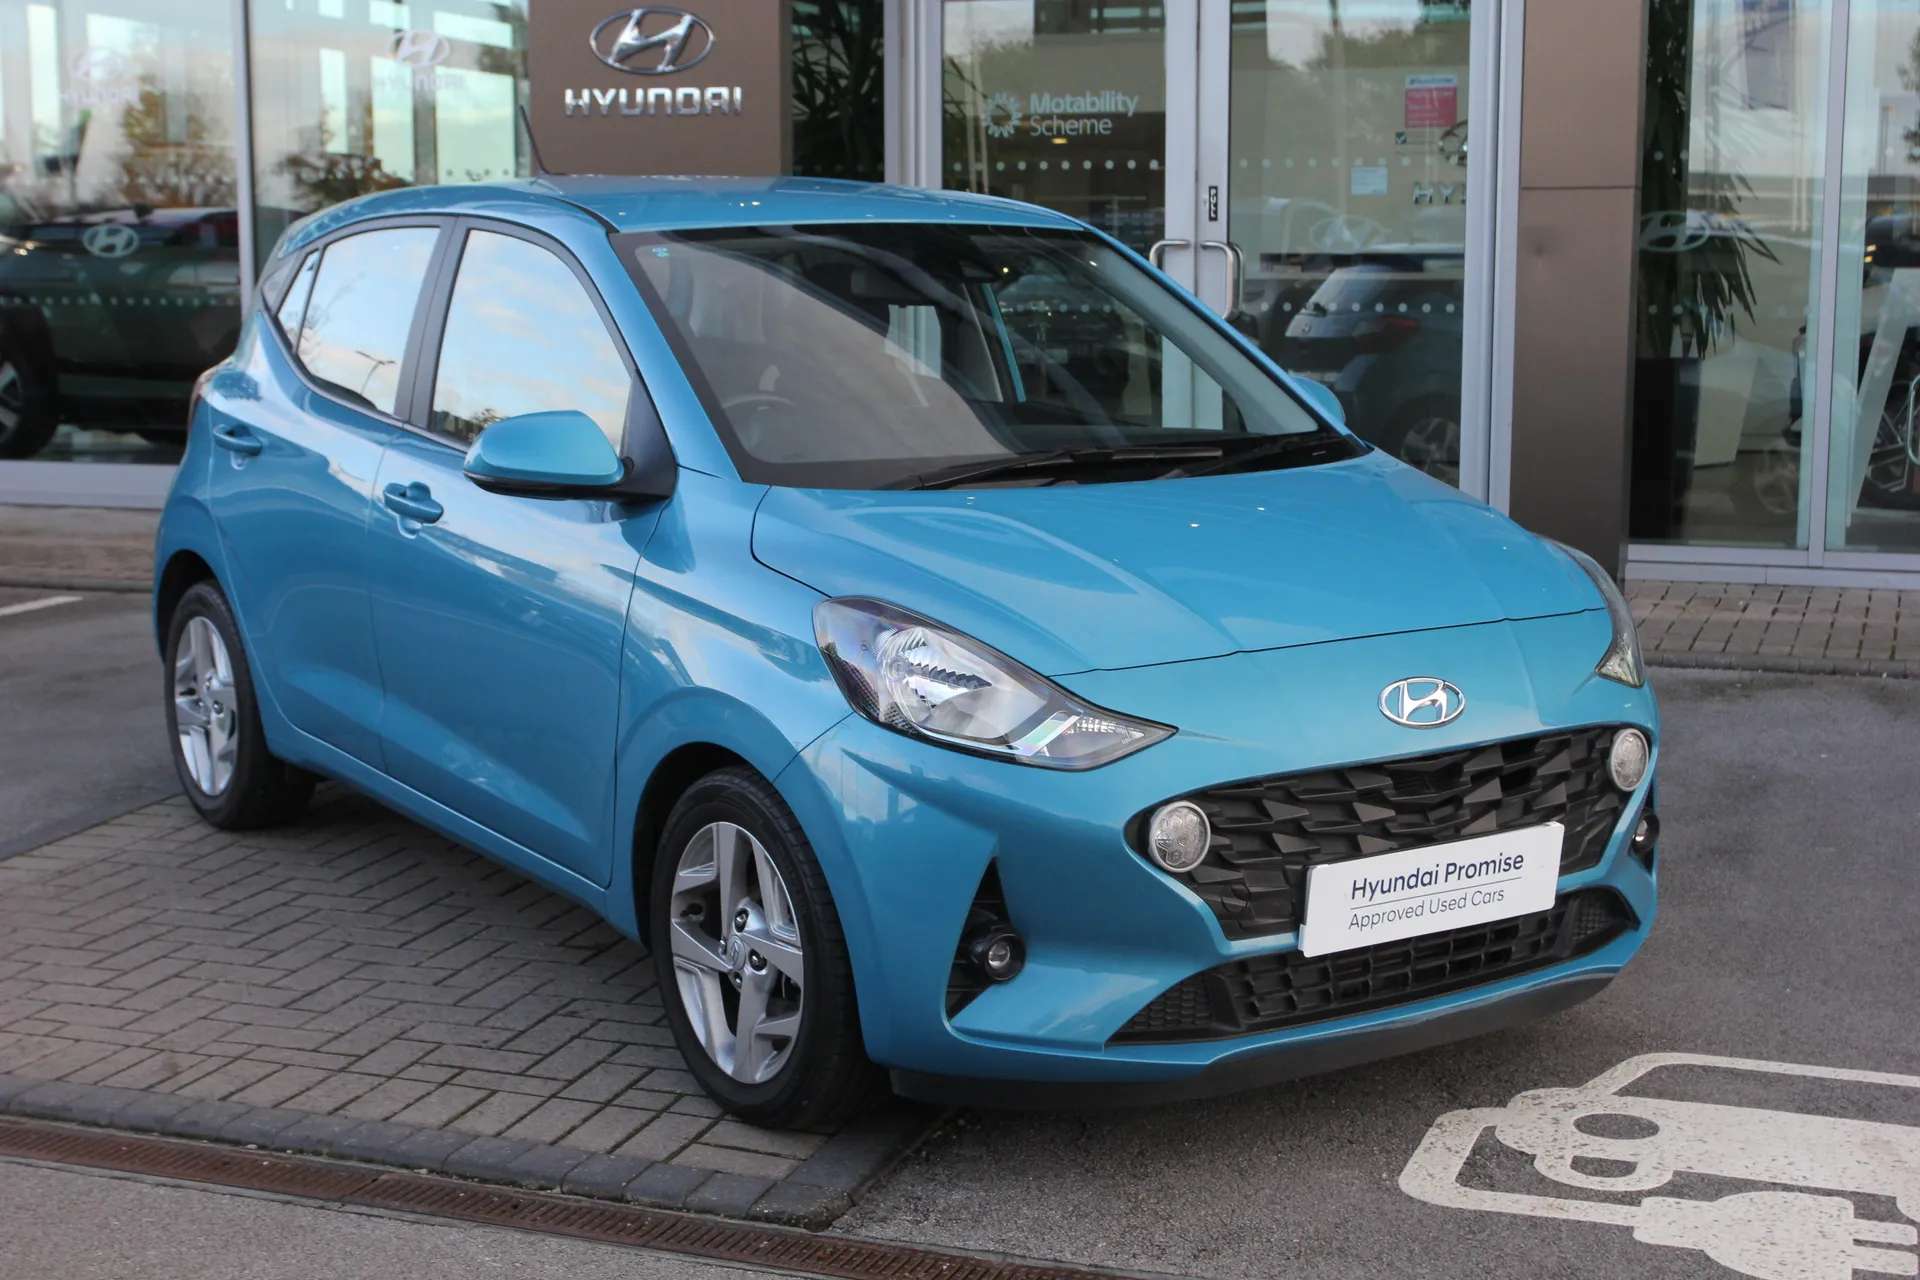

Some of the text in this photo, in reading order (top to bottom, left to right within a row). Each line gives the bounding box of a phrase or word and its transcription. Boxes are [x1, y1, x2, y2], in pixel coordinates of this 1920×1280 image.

[564, 86, 743, 117] HYUNDAI
[1029, 90, 1138, 117] Motability
[1029, 115, 1113, 136] Scheme
[1351, 852, 1524, 902] Hyundai Promise
[1348, 889, 1504, 931] Approved Used Cars
